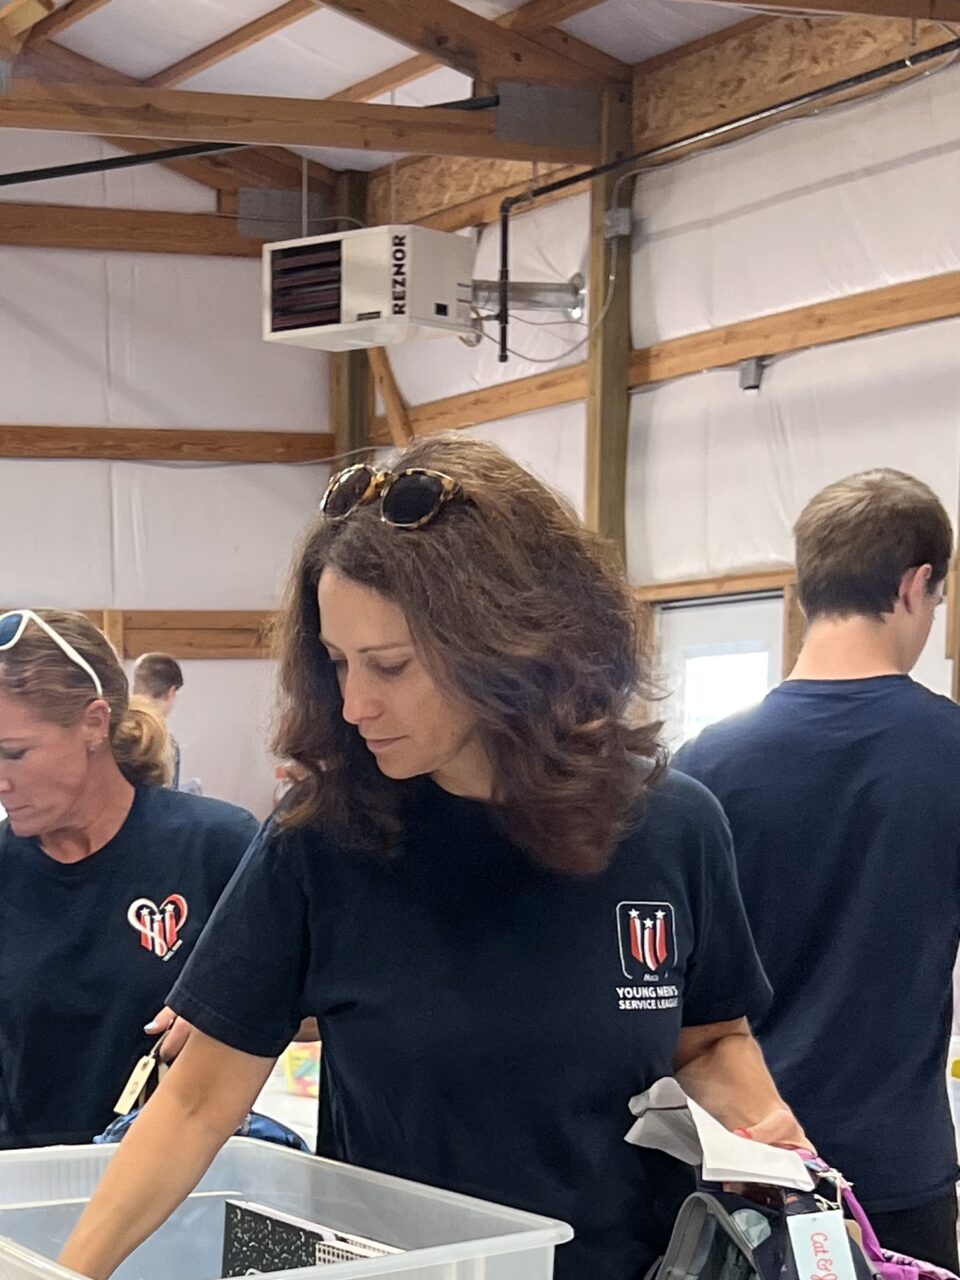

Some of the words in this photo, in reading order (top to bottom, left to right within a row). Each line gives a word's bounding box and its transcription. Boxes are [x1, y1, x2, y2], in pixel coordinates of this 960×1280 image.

[391, 234, 407, 316] REZNOR
[615, 986, 657, 999] YOUNG
[618, 999, 657, 1010] SERVICE
[810, 1231, 830, 1257] Cat
